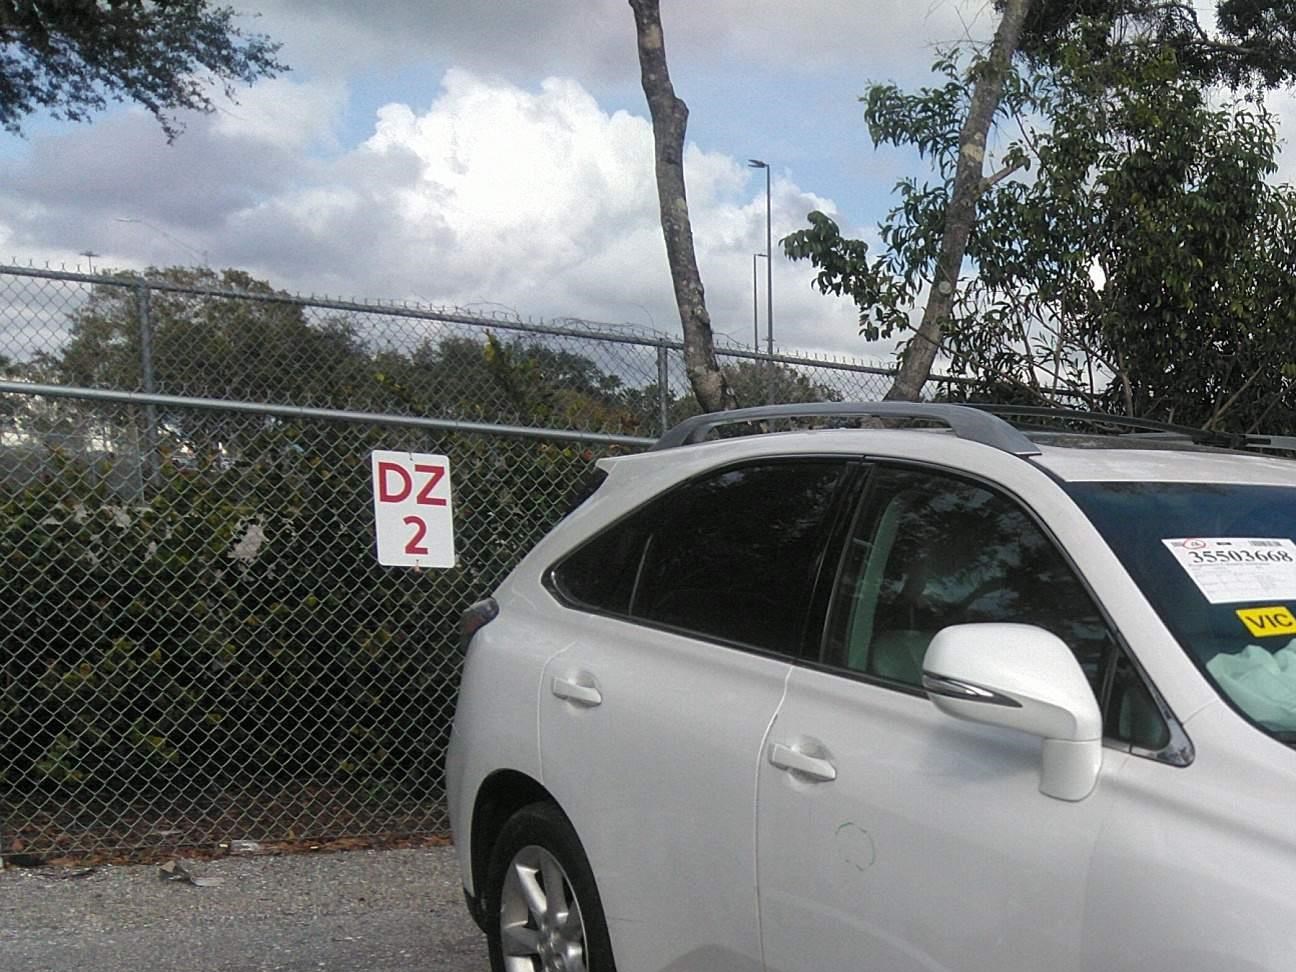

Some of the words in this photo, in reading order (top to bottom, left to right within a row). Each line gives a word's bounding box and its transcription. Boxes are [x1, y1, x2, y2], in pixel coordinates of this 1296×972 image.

[378, 461, 447, 506] DZ
[403, 515, 429, 555] 2
[1188, 550, 1294, 564] 35503668
[1247, 613, 1294, 629] VIC
